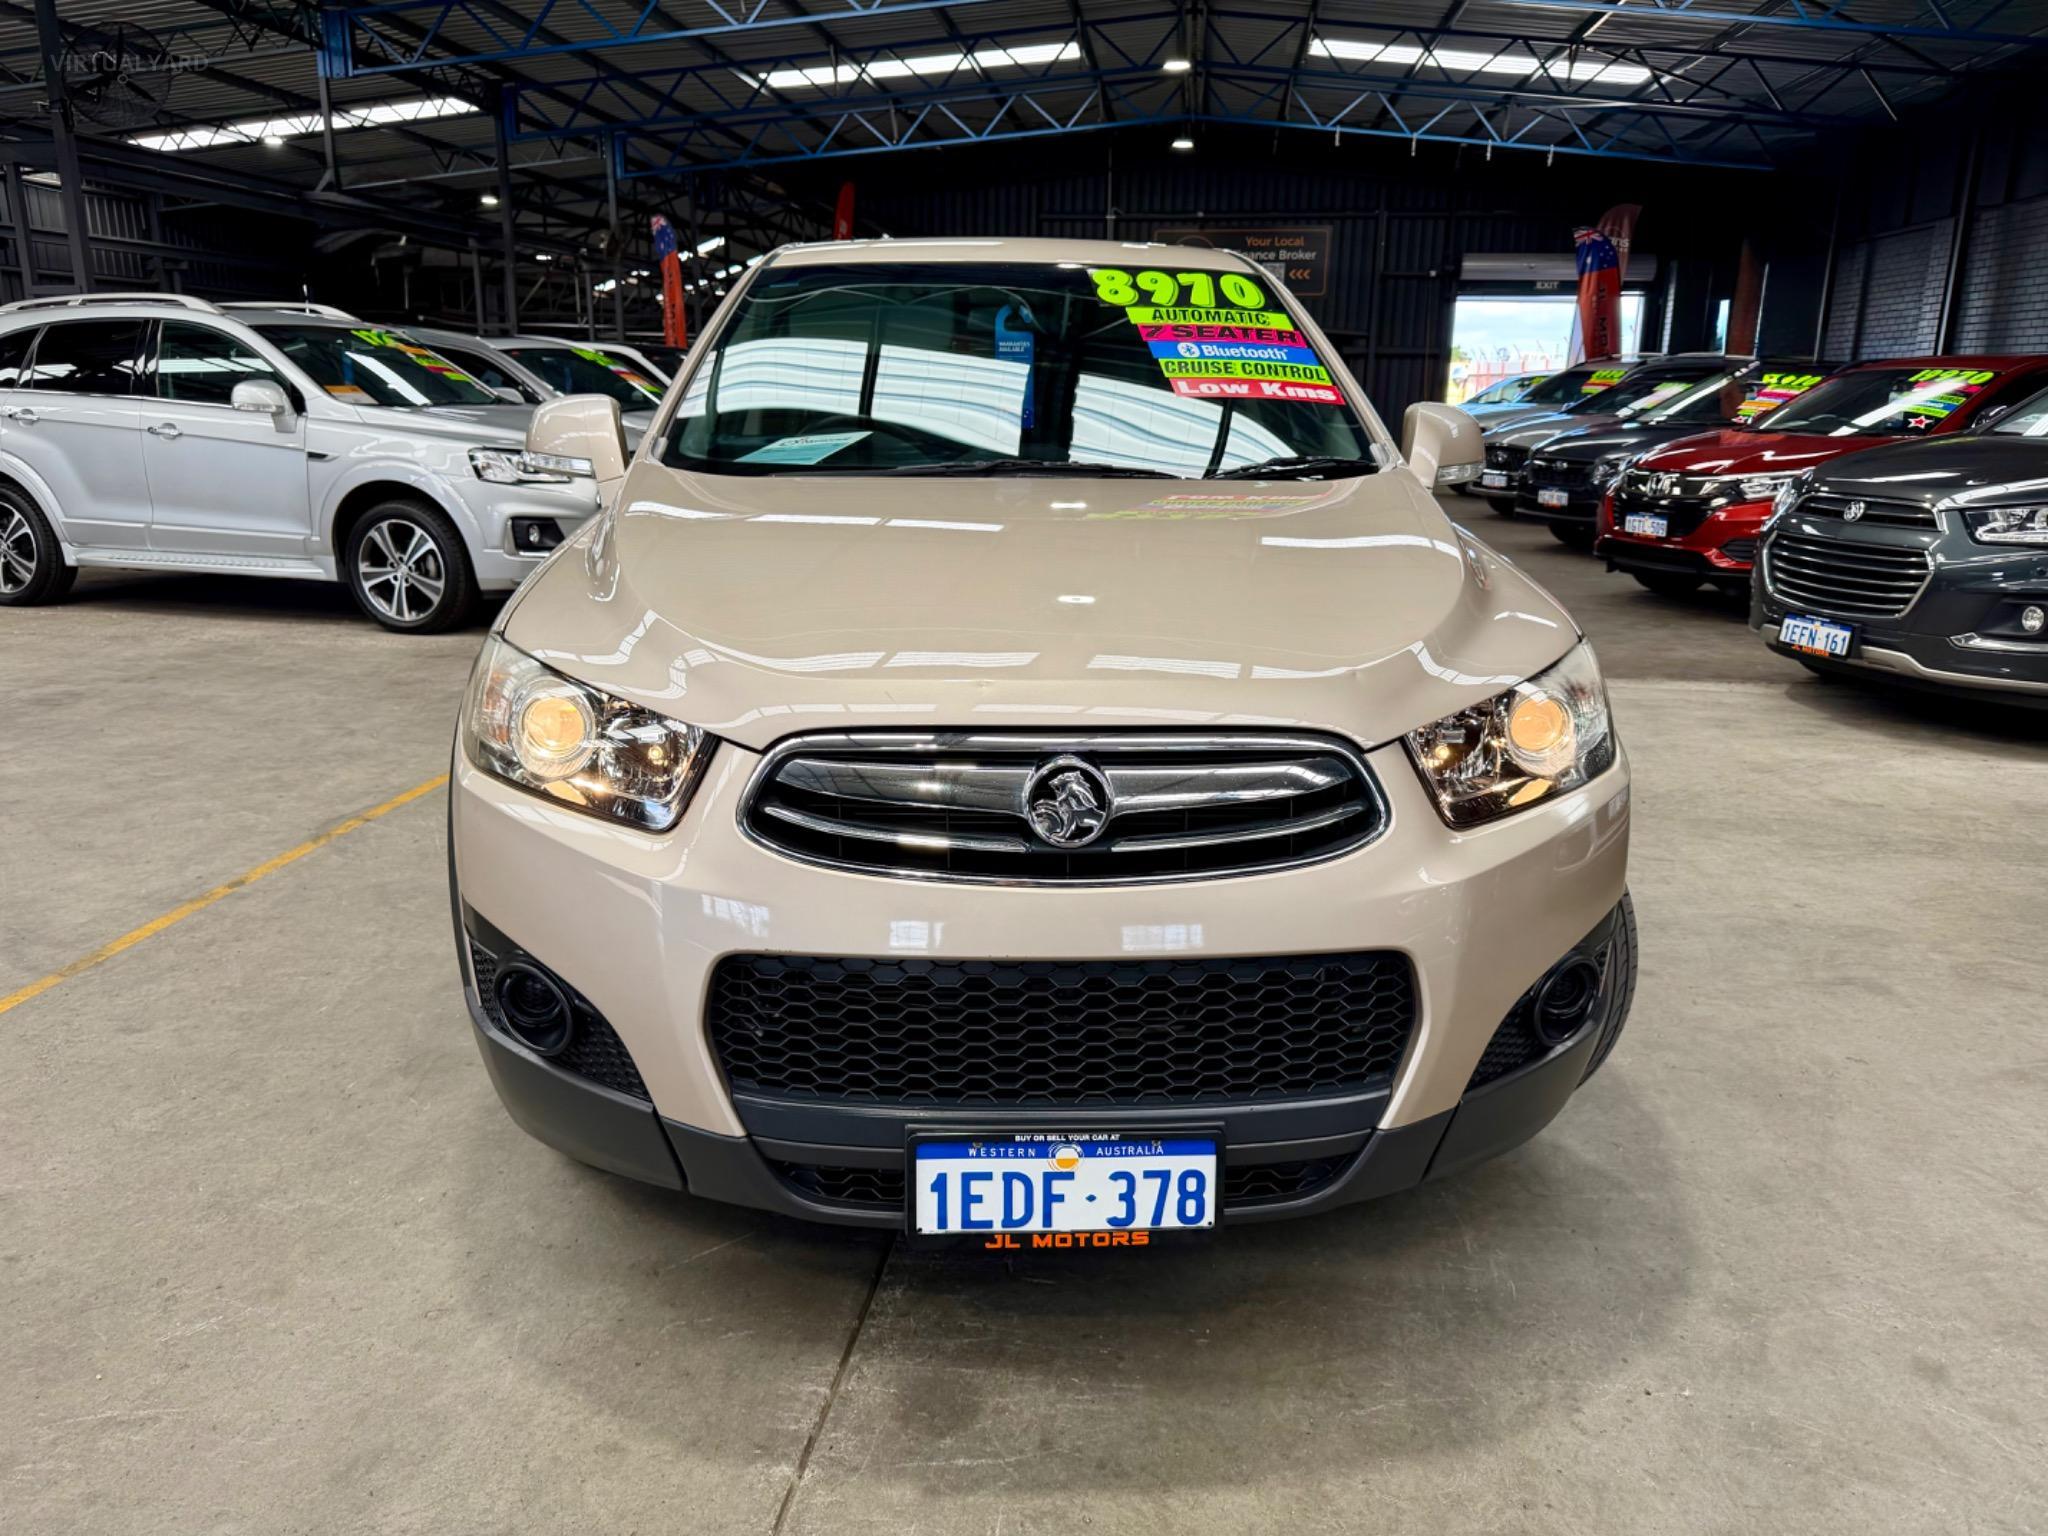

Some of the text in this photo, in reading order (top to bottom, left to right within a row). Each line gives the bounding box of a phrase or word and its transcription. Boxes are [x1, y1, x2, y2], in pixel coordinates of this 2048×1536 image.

[1246, 236, 1304, 247] Your Local
[1279, 248, 1317, 260] Broker
[1091, 269, 1265, 309] 8970
[1536, 281, 1559, 289] EXIT
[1152, 309, 1271, 326] AUTOMATIC
[1143, 326, 1298, 343] 7 SEATER
[1201, 344, 1287, 360] Bluetooth
[1164, 361, 1326, 381] CRUISE CONTROL
[1178, 380, 1337, 400] Low Kms
[1015, 1133, 1121, 1142] BUY OR SELL YOUR CAR AT
[968, 1145, 1164, 1157] WESTERN AUSTRALIA
[985, 1231, 1150, 1249] JL MOTORS
